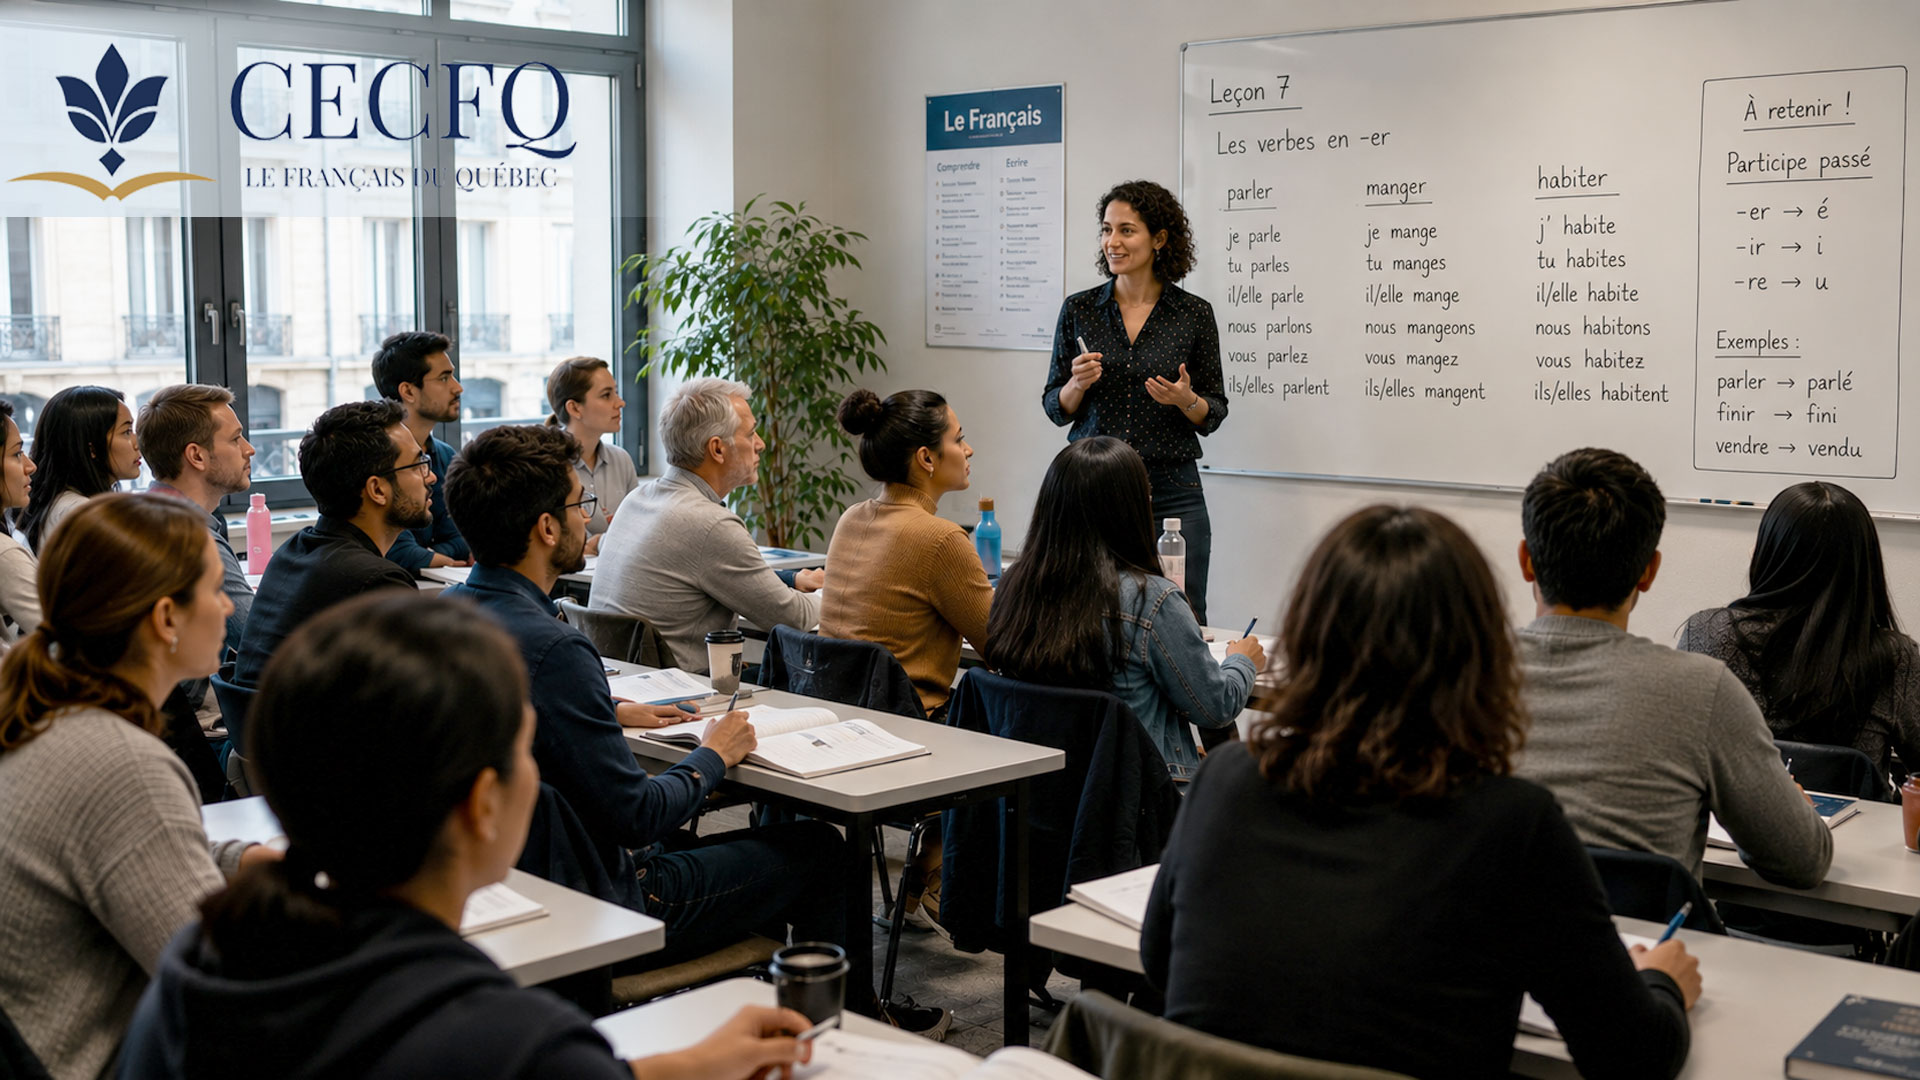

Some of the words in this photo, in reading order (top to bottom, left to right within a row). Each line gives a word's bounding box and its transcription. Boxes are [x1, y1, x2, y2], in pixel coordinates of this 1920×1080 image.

[1210, 77, 1266, 108] Leçon
[1276, 74, 1291, 100] 7
[944, 110, 965, 132] Le
[969, 104, 1042, 133] Français
[1743, 93, 1758, 122] À
[1768, 98, 1833, 120] retenir
[1217, 130, 1247, 156] Les
[1256, 128, 1316, 153] verbes
[1327, 134, 1349, 150] en
[1727, 150, 1808, 178] Participe
[1819, 145, 1871, 177] passé
[1537, 164, 1609, 190] habiter
[1227, 178, 1272, 209] parler
[1365, 181, 1427, 205] manger
[1816, 196, 1829, 220] é
[1363, 223, 1381, 249] je
[1390, 226, 1438, 247] mange
[1563, 213, 1617, 236] habite
[1225, 227, 1241, 252] je
[1248, 225, 1282, 251] parle
[1816, 235, 1824, 256] i
[1227, 258, 1243, 274] tu
[1250, 256, 1290, 280] parles
[1365, 255, 1383, 272] tu
[1392, 257, 1447, 279] manges
[1536, 251, 1557, 270] tu
[1566, 247, 1627, 269] habites
[1536, 280, 1579, 306] il/elle
[1587, 280, 1640, 303] habite
[1815, 276, 1829, 291] u
[1227, 285, 1263, 307] il/elle
[1271, 285, 1305, 311] parle
[1365, 283, 1404, 306] il/elle
[1412, 290, 1461, 311] mange
[1227, 321, 1257, 334] nous
[1265, 317, 1313, 341] parlons
[1364, 322, 1397, 335] nous
[1407, 322, 1476, 344] mangeons
[1535, 323, 1572, 336] nous
[1583, 314, 1651, 336] habitons
[1716, 328, 1790, 355] Exemples
[1227, 351, 1257, 363] vous
[1267, 347, 1309, 371] parlez
[1364, 352, 1397, 366] vous
[1406, 354, 1460, 375] mangez
[1535, 355, 1572, 369] vous
[1584, 347, 1646, 370] habitez
[1228, 374, 1275, 397] ils/elles
[1282, 377, 1330, 402] parlent
[1364, 377, 1416, 401] ils/elles
[1424, 381, 1487, 407] mangent
[1534, 380, 1592, 405] ils/elles
[1600, 381, 1670, 403] habitent
[1717, 369, 1767, 398] parler
[1807, 369, 1854, 399] parlé
[1716, 400, 1756, 422] finir
[1805, 402, 1837, 424] fini
[1715, 435, 1770, 456] vendre
[1807, 435, 1863, 459] vendu
